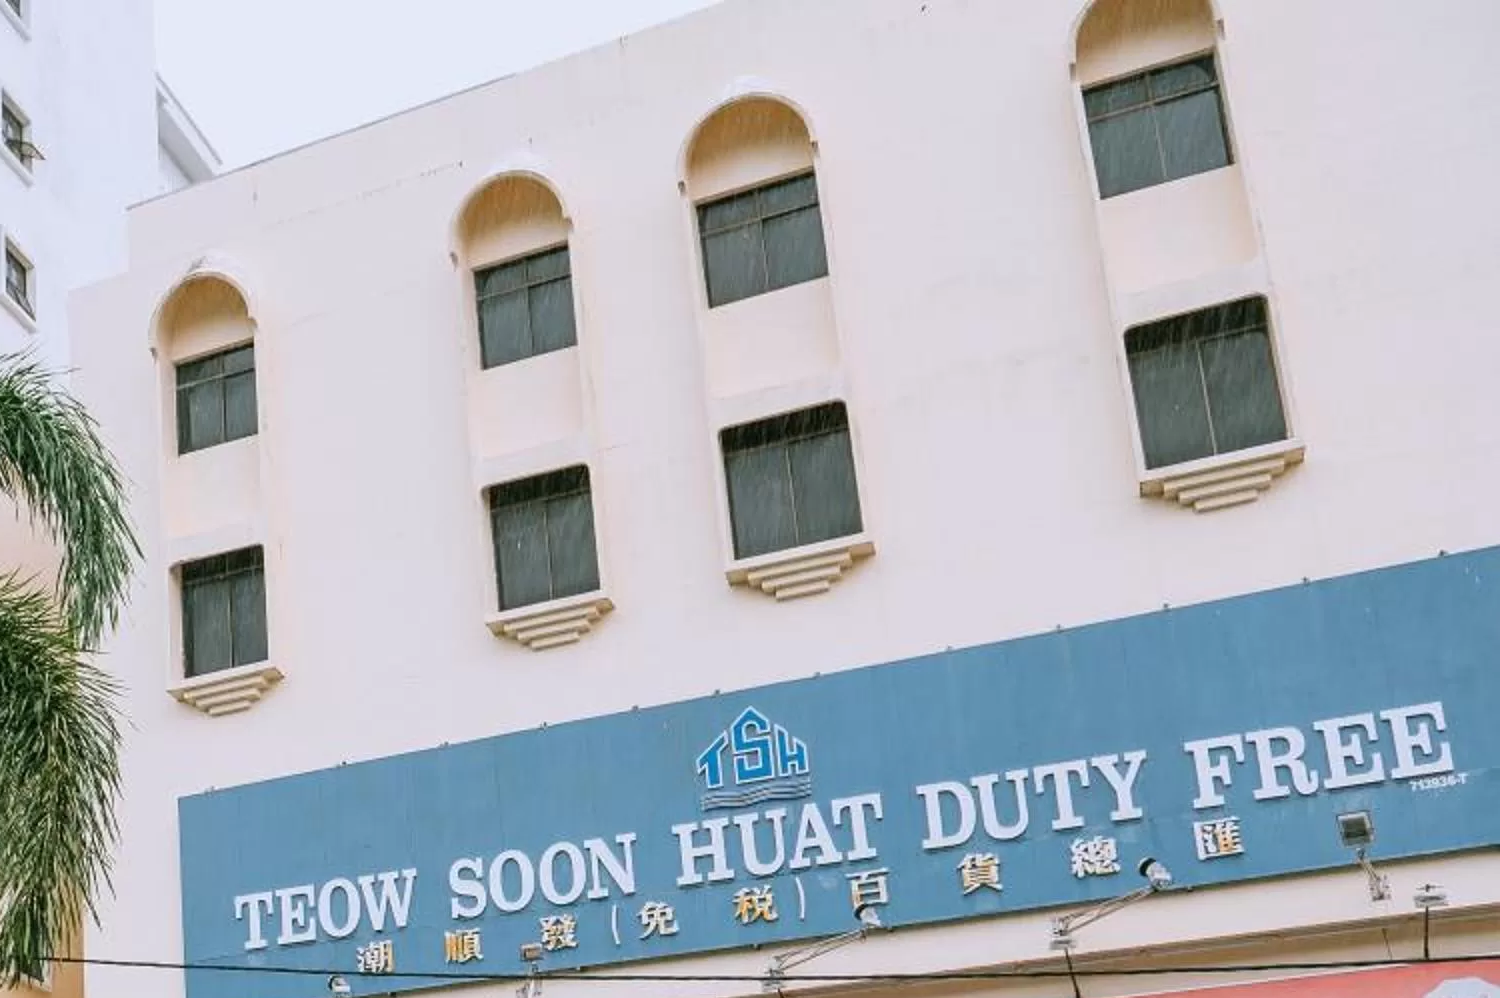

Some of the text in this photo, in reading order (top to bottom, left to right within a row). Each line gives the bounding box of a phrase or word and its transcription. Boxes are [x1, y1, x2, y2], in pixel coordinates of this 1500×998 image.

[235, 701, 1455, 951] TEOW SOON HUAT DUTY FREE
[696, 705, 809, 788] TSH
